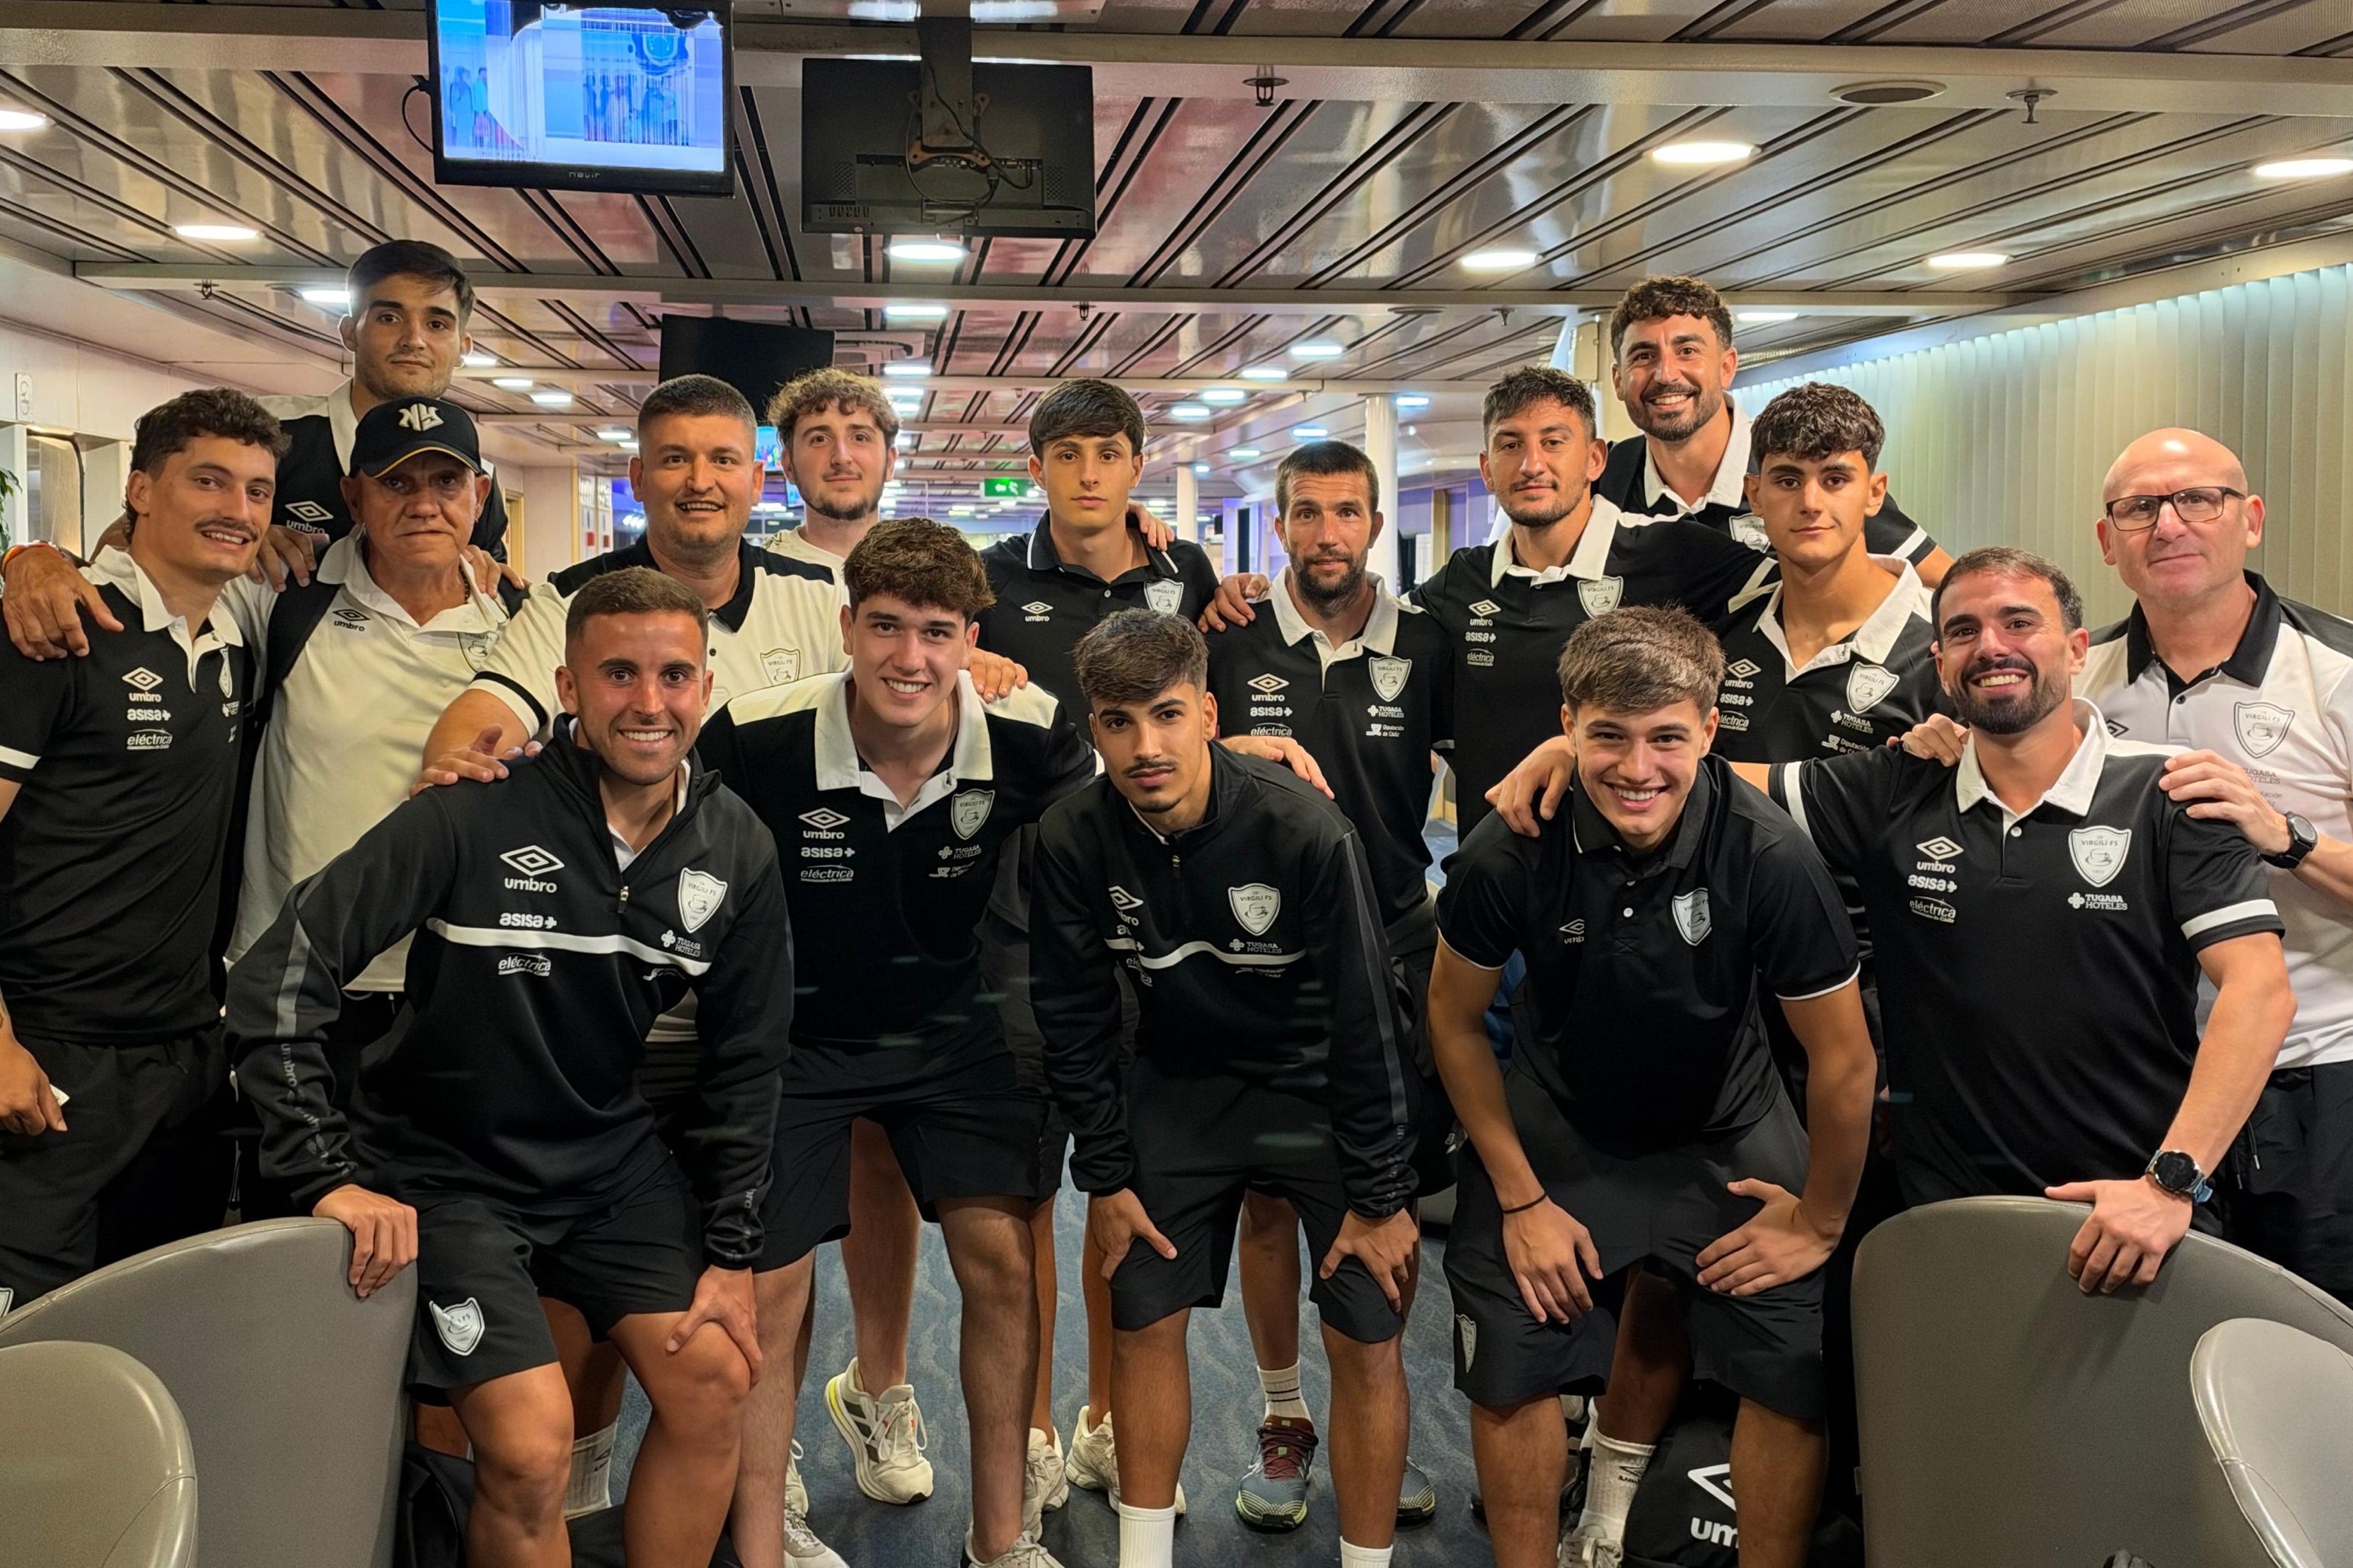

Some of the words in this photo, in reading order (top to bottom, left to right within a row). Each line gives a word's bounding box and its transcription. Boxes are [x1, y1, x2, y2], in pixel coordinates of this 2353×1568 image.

[334, 620, 365, 632] umbro
[1469, 617, 1493, 627] umbro
[1725, 679, 1754, 690] umbro
[129, 691, 162, 702] umbro
[1251, 693, 1285, 702] umbro
[1719, 714, 1750, 728] léctrica
[2244, 768, 2277, 778] UGASA
[803, 830, 845, 840] umbro
[1916, 860, 1956, 873] umbro
[504, 877, 557, 893] umbro
[2085, 894, 2124, 902] TUGASA
[2085, 902, 2128, 910] HOTELES
[1564, 936, 1585, 944] umb
[281, 1043, 297, 1088] umbro
